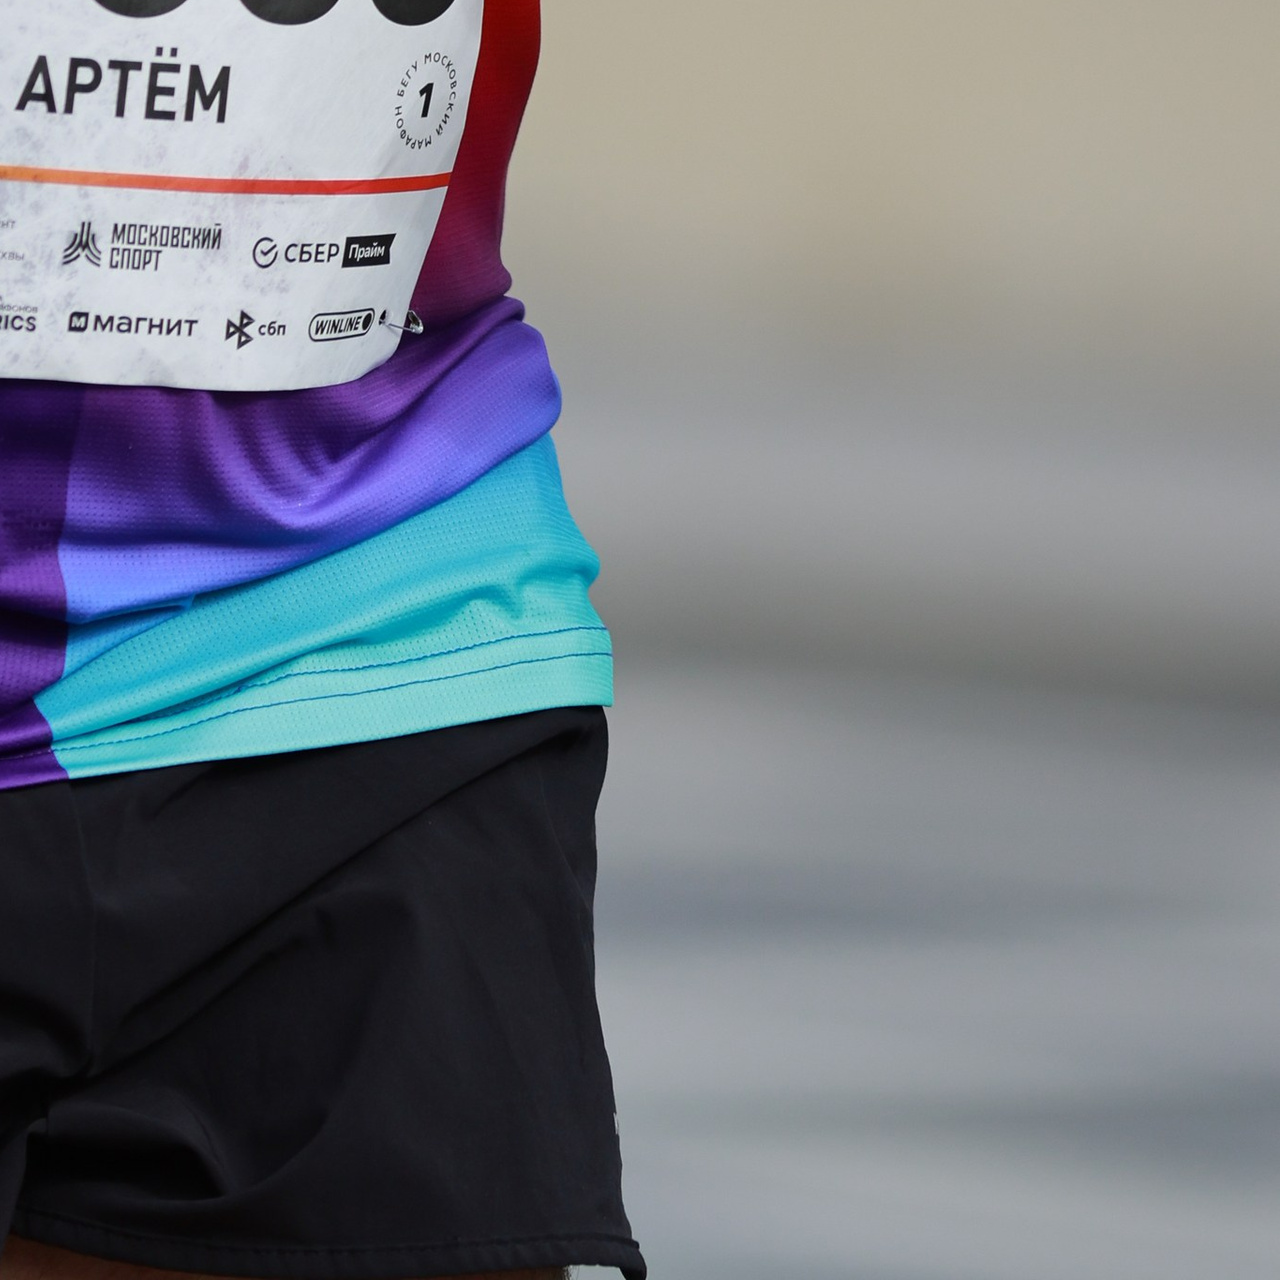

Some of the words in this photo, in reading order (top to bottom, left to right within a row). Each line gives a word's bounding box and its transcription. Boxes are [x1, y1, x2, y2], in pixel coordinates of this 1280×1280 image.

[15, 46, 231, 123] АРТЁМ
[424, 52, 457, 136] МОСКОВСКИЙ
[419, 82, 435, 118] 1
[394, 105, 432, 150] МАРАФОН
[111, 222, 222, 250] МОСКОВСКИЙ
[109, 247, 162, 271] СПОРТ
[284, 243, 340, 263] СБЕР
[348, 241, 385, 262] Прайм
[93, 315, 198, 337] магнит
[258, 321, 286, 336] сбп
[314, 316, 363, 335] WINLINE
